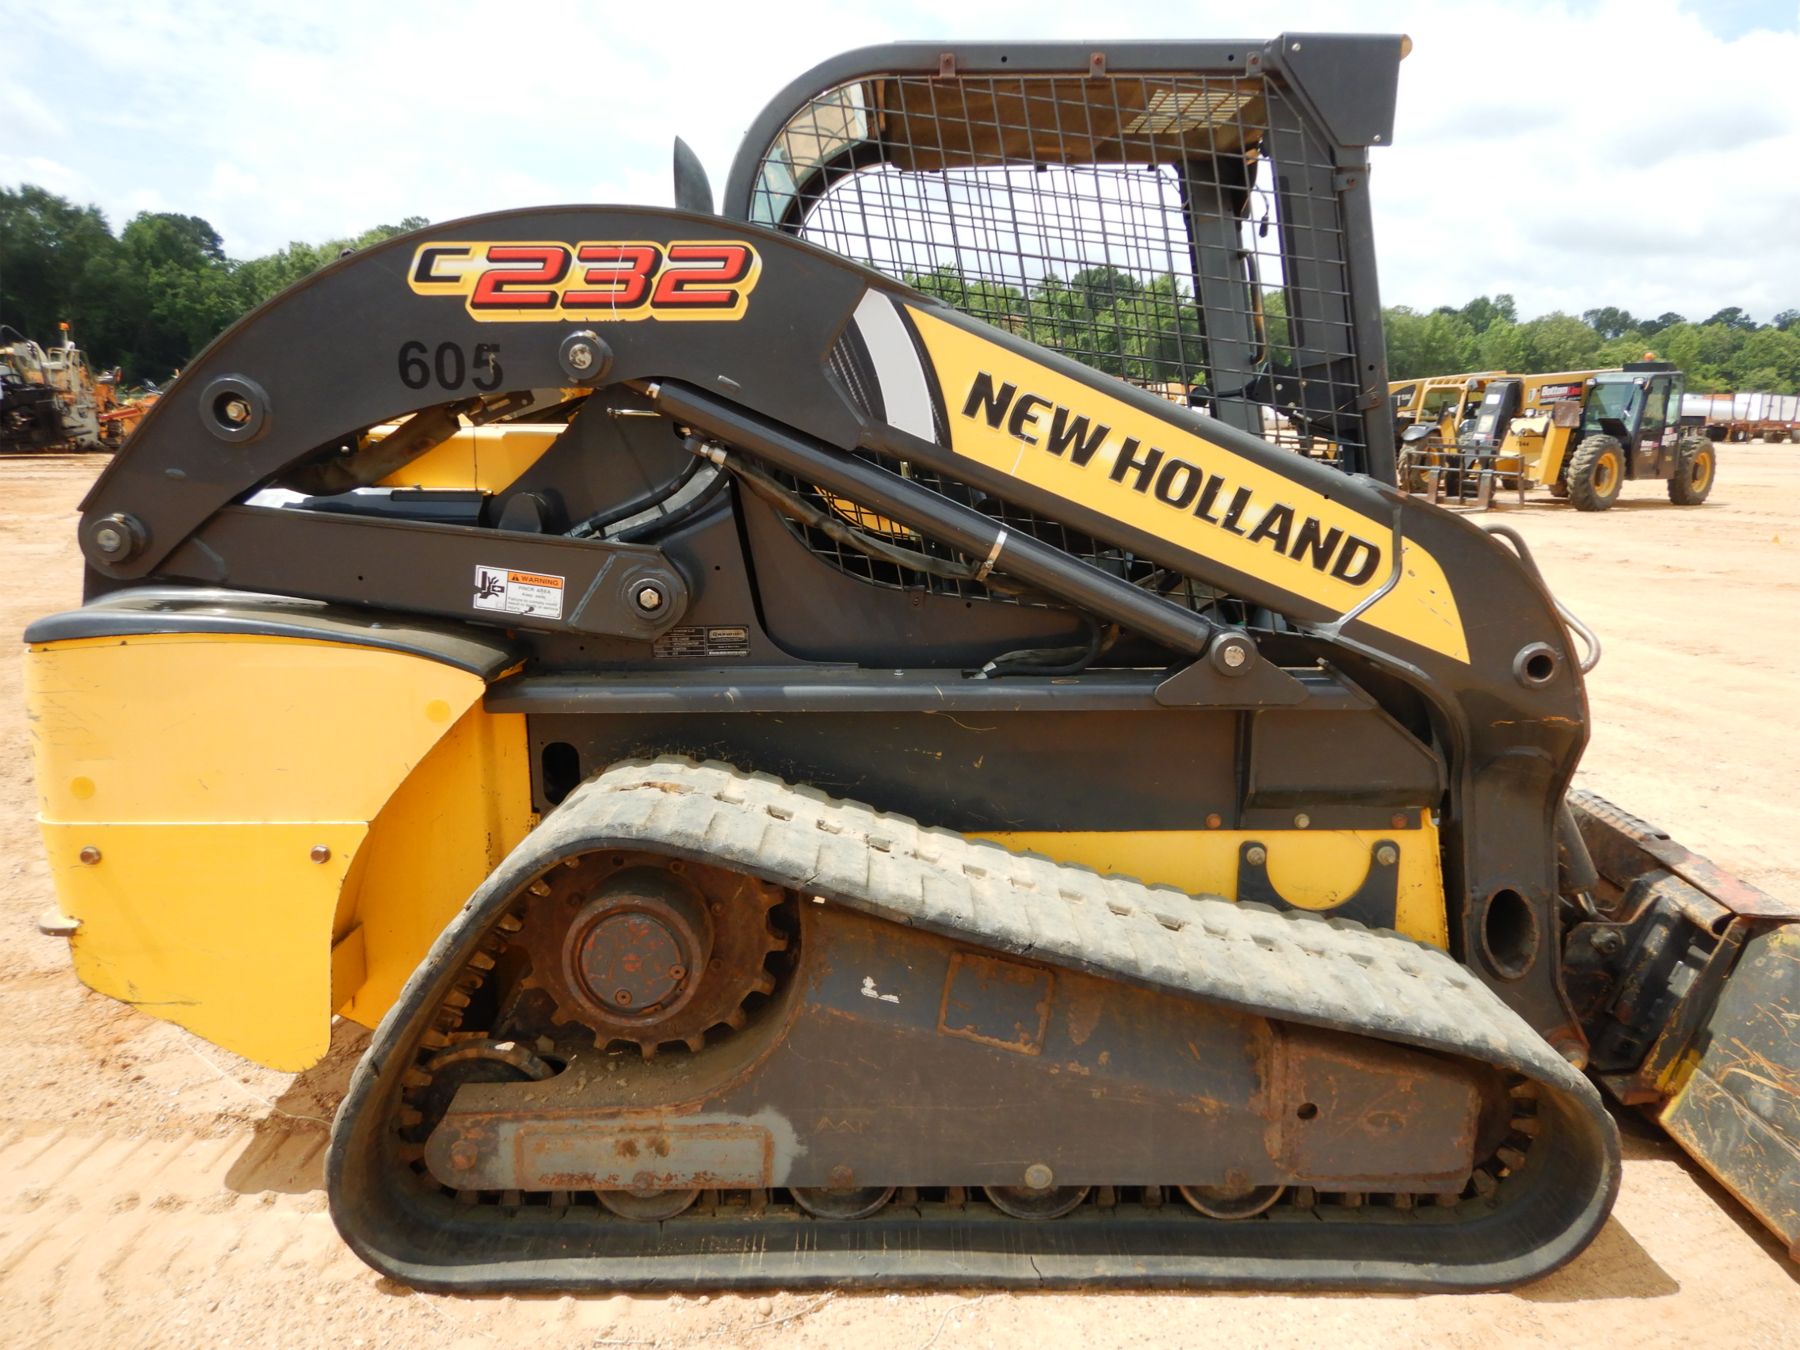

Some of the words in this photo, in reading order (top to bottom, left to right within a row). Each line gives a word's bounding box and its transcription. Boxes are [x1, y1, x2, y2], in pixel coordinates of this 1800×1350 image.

[411, 243, 751, 312] C232
[398, 340, 504, 391] 605
[961, 370, 1111, 469] NEW
[1108, 436, 1382, 587] HOLLAND
[520, 576, 559, 586] WARNING
